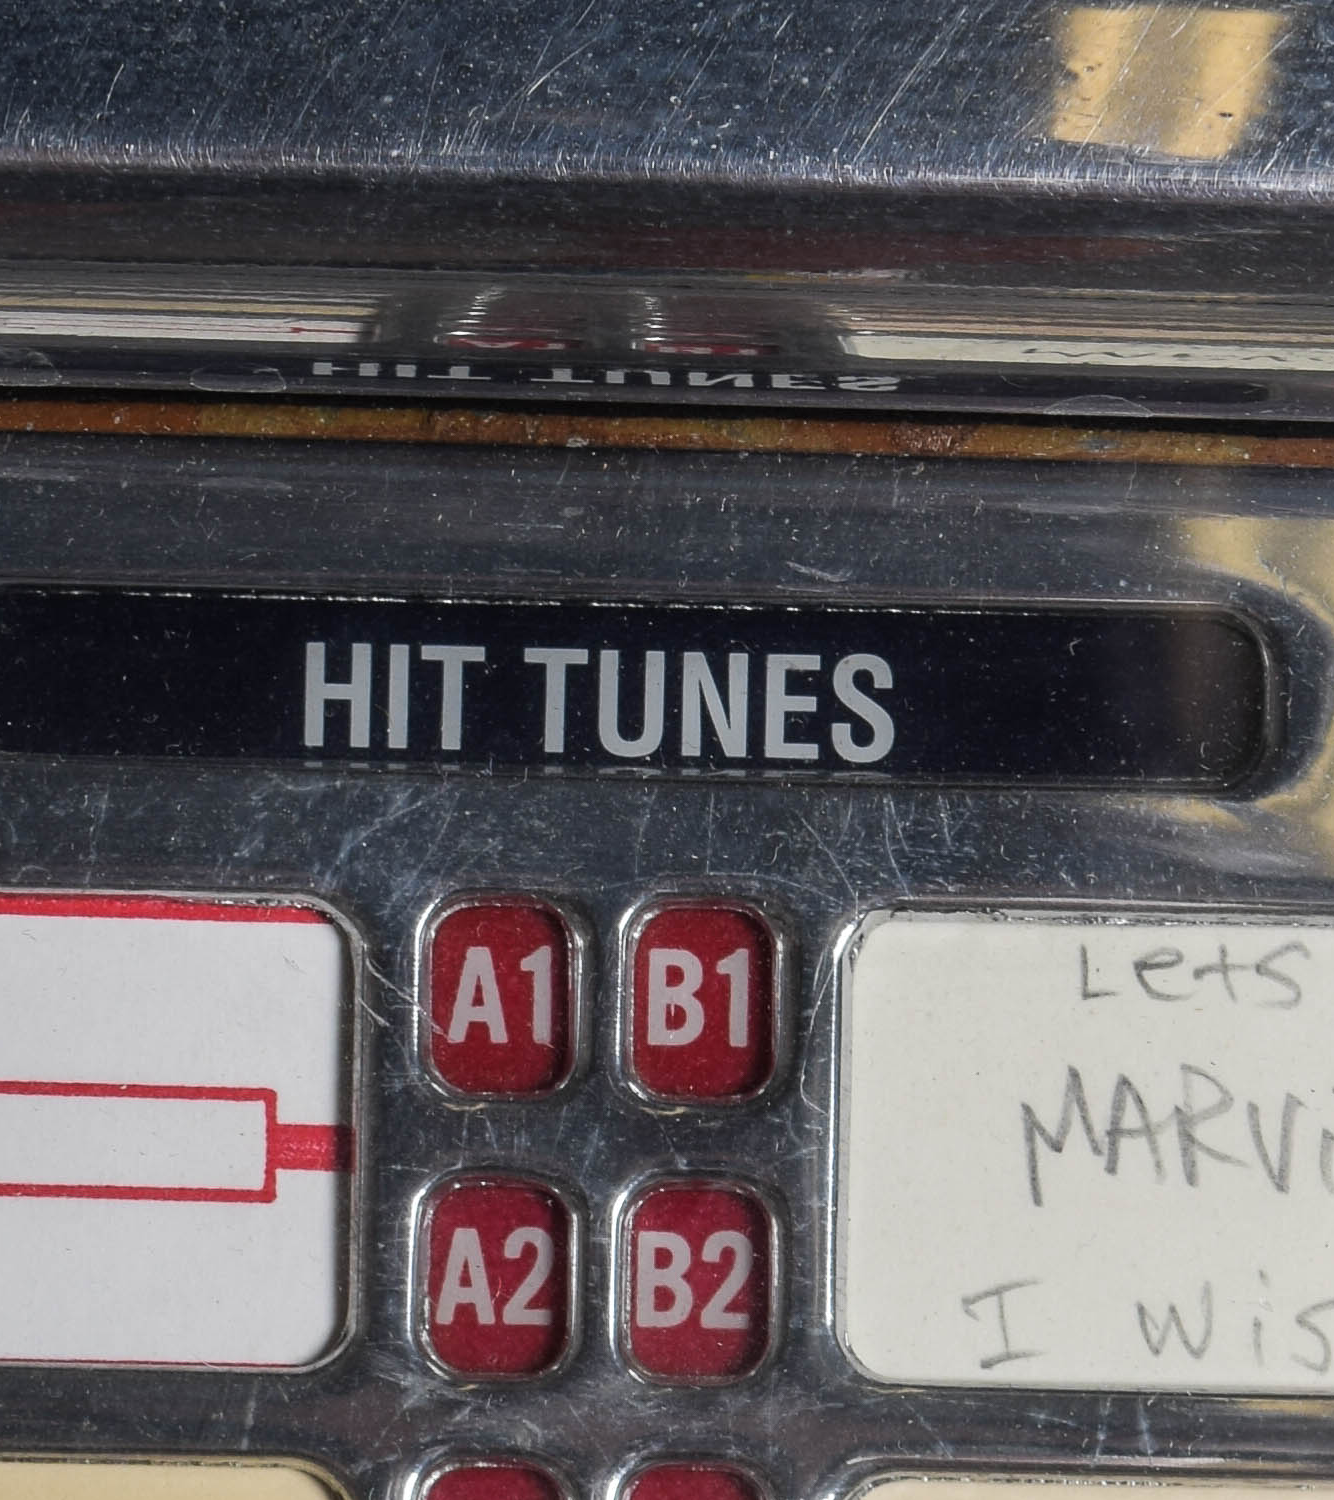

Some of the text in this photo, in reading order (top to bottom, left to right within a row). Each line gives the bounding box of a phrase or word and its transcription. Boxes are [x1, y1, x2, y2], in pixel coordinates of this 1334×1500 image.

[304, 642, 894, 763] HIT TUNES
[448, 946, 552, 1044] A1
[647, 948, 749, 1048] B1
[435, 1226, 555, 1328] A2
[636, 1229, 753, 1331] B2
